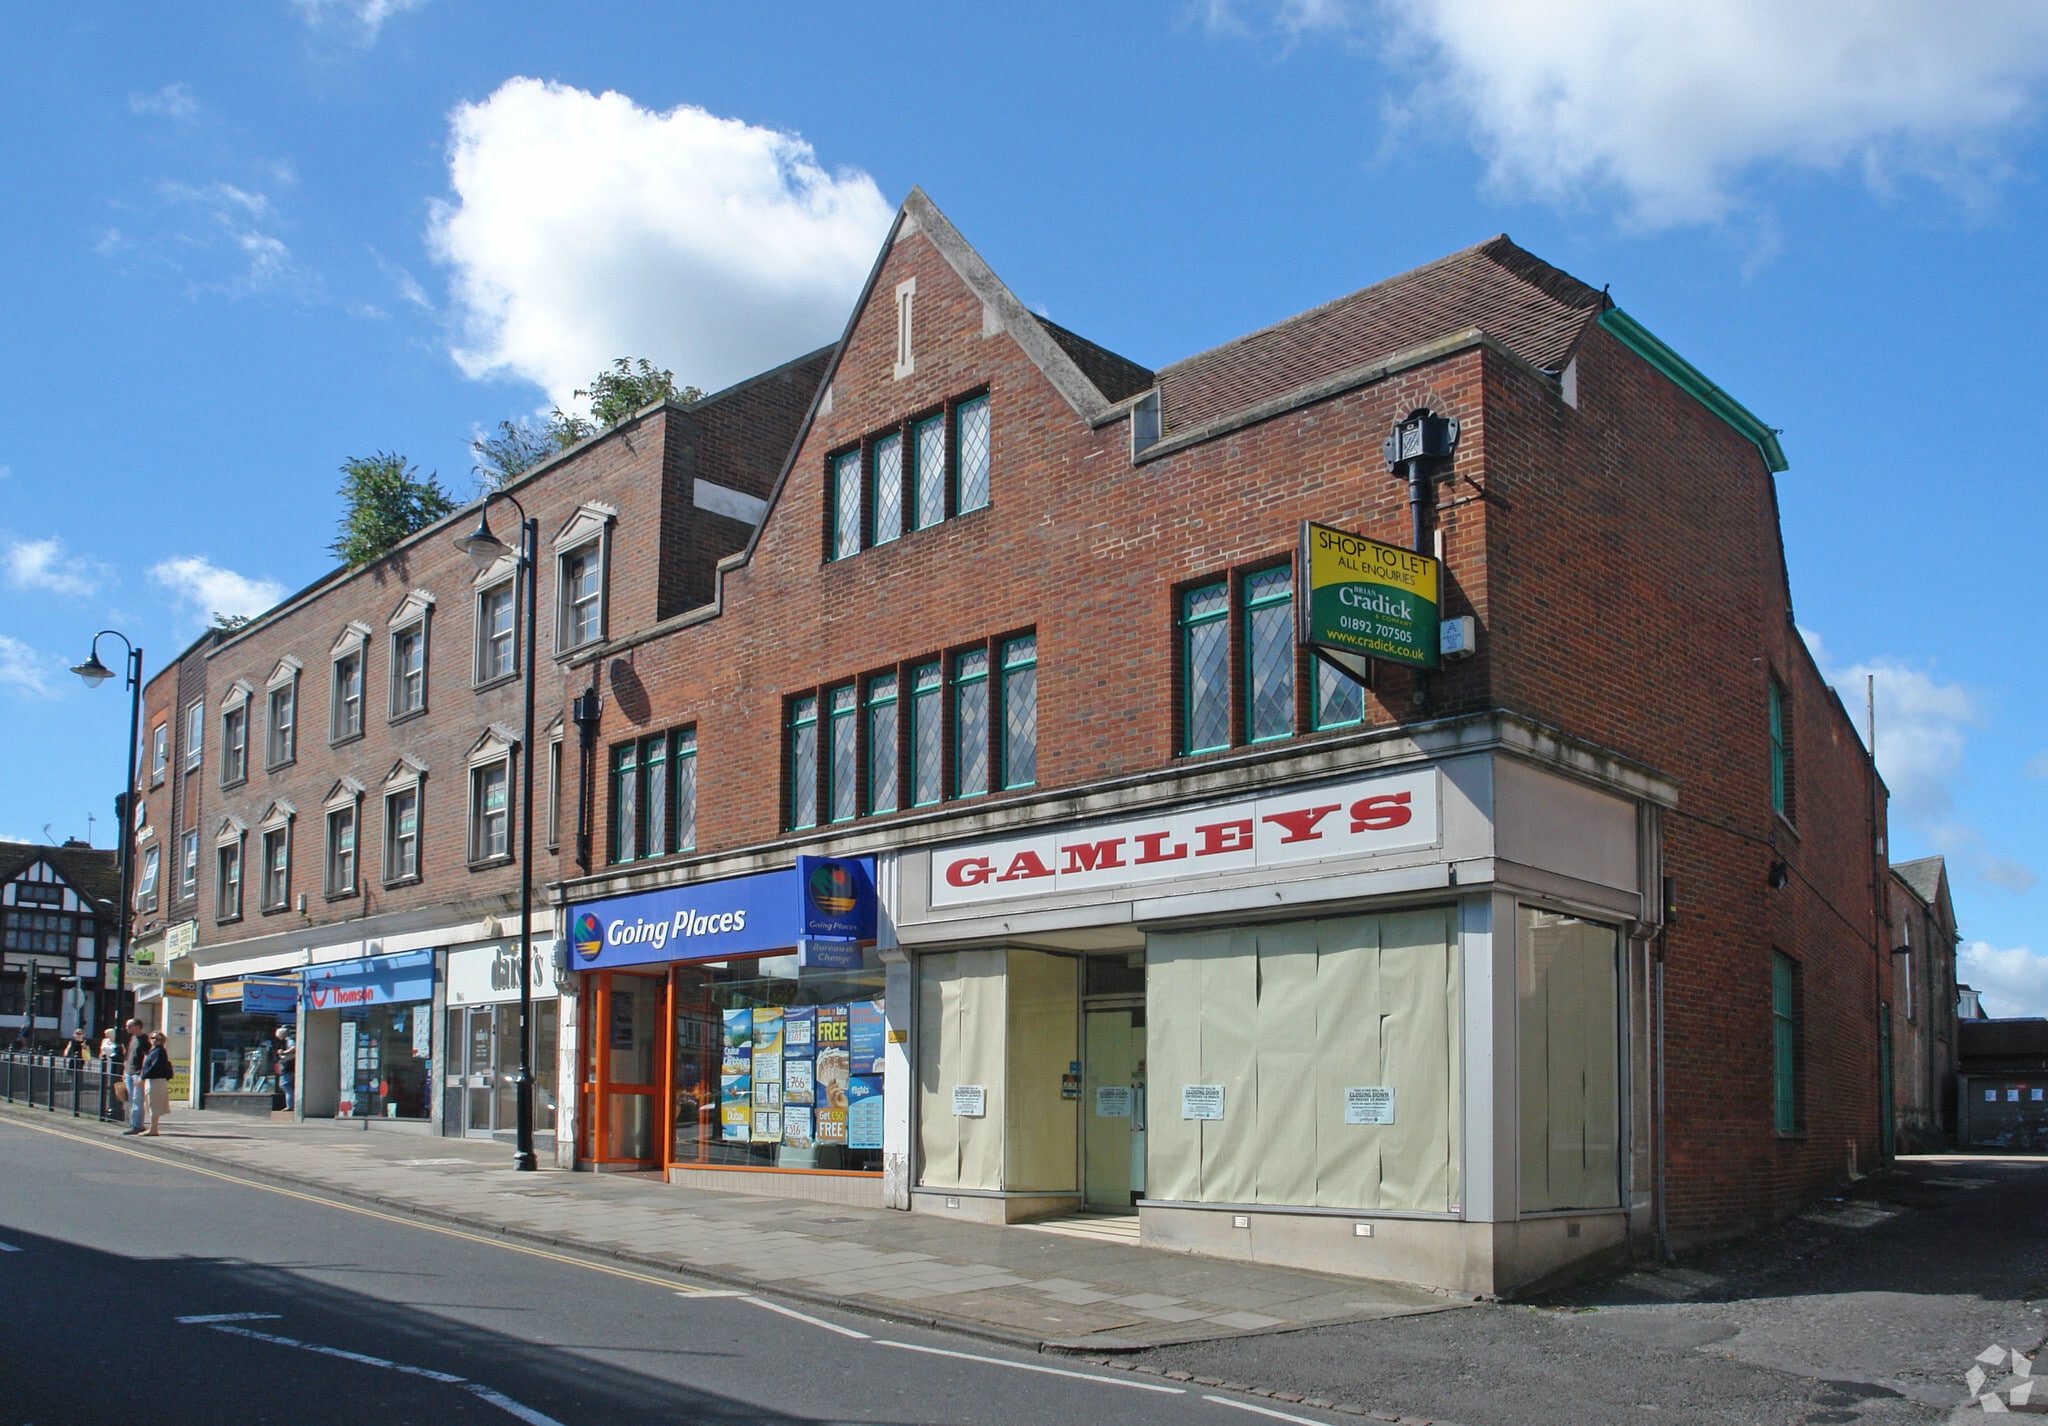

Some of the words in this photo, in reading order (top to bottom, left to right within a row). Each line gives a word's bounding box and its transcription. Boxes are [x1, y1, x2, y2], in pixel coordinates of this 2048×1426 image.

[1319, 531, 1366, 557] SHOP
[1371, 545, 1397, 567] TO
[1401, 554, 1430, 576] LET
[1338, 557, 1359, 571] ALL
[1362, 562, 1416, 586] ENQUIRIES
[1353, 586, 1377, 597] BRIAN
[1339, 586, 1412, 621] Cradick
[1340, 615, 1373, 633] 01892
[1376, 623, 1413, 643] 707505
[1326, 629, 1425, 661] www.cradick.co.uk
[945, 791, 1412, 888] GAMLEYS
[607, 909, 670, 950] Going
[671, 909, 746, 939] Places
[809, 920, 832, 931] Going
[833, 922, 858, 931] Places
[812, 942, 844, 952] Bureau
[845, 944, 857, 953] de
[817, 952, 852, 965] Change
[332, 987, 374, 1004] Thomson
[836, 1007, 848, 1015] late
[818, 1021, 848, 1041] FREE
[851, 1086, 870, 1096] flights
[727, 1110, 745, 1121] Dubai
[820, 1111, 830, 1120] Get
[819, 1121, 844, 1137] FREE
